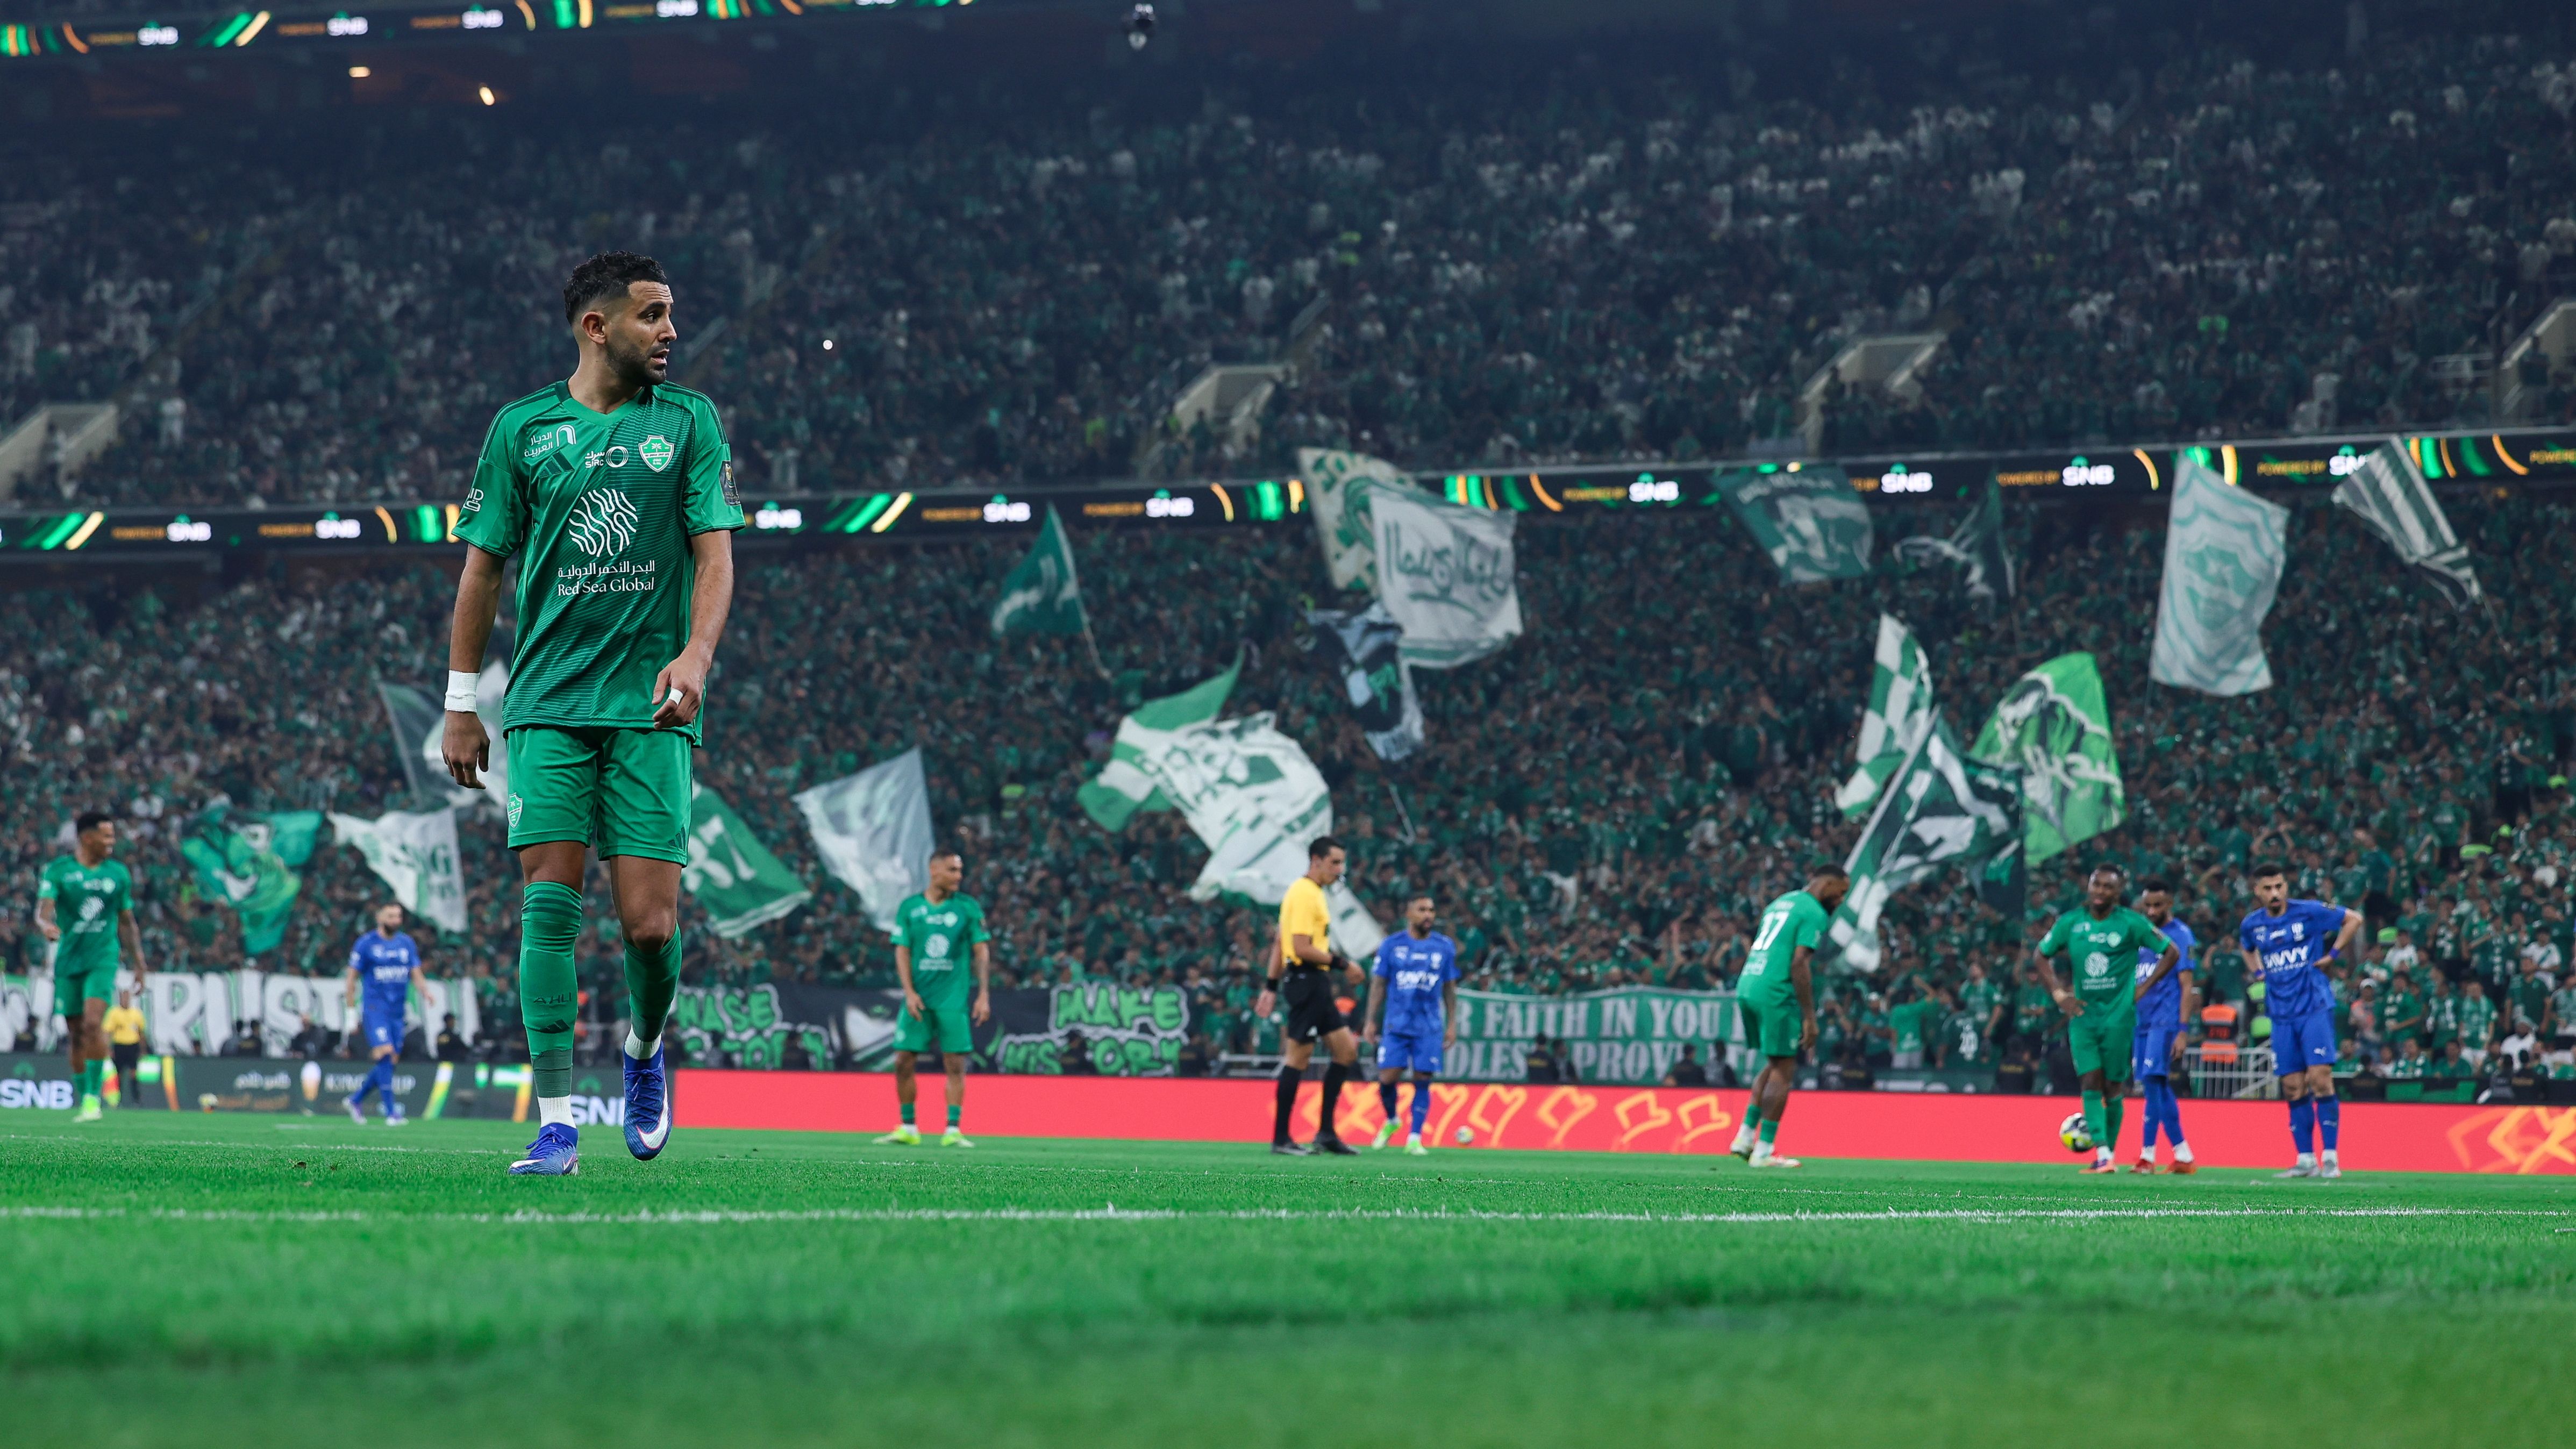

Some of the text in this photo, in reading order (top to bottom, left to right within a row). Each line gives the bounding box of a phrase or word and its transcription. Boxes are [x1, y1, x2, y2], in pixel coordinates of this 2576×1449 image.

[585, 460, 604, 468] SIRC
[2063, 465, 2115, 486] SNB
[1881, 472, 1933, 493] SNB
[558, 560, 655, 579] البحر الأحمر الدولية
[558, 577, 654, 596] Red Sea Global
[1751, 910, 1789, 951] 17
[1054, 986, 1183, 1031] MAKE
[1482, 1001, 1588, 1038] FAITH
[1598, 997, 1638, 1038] IN
[1648, 998, 1721, 1040] YOU
[1571, 1041, 1684, 1081] PROV
[0, 1079, 74, 1110] SNB
